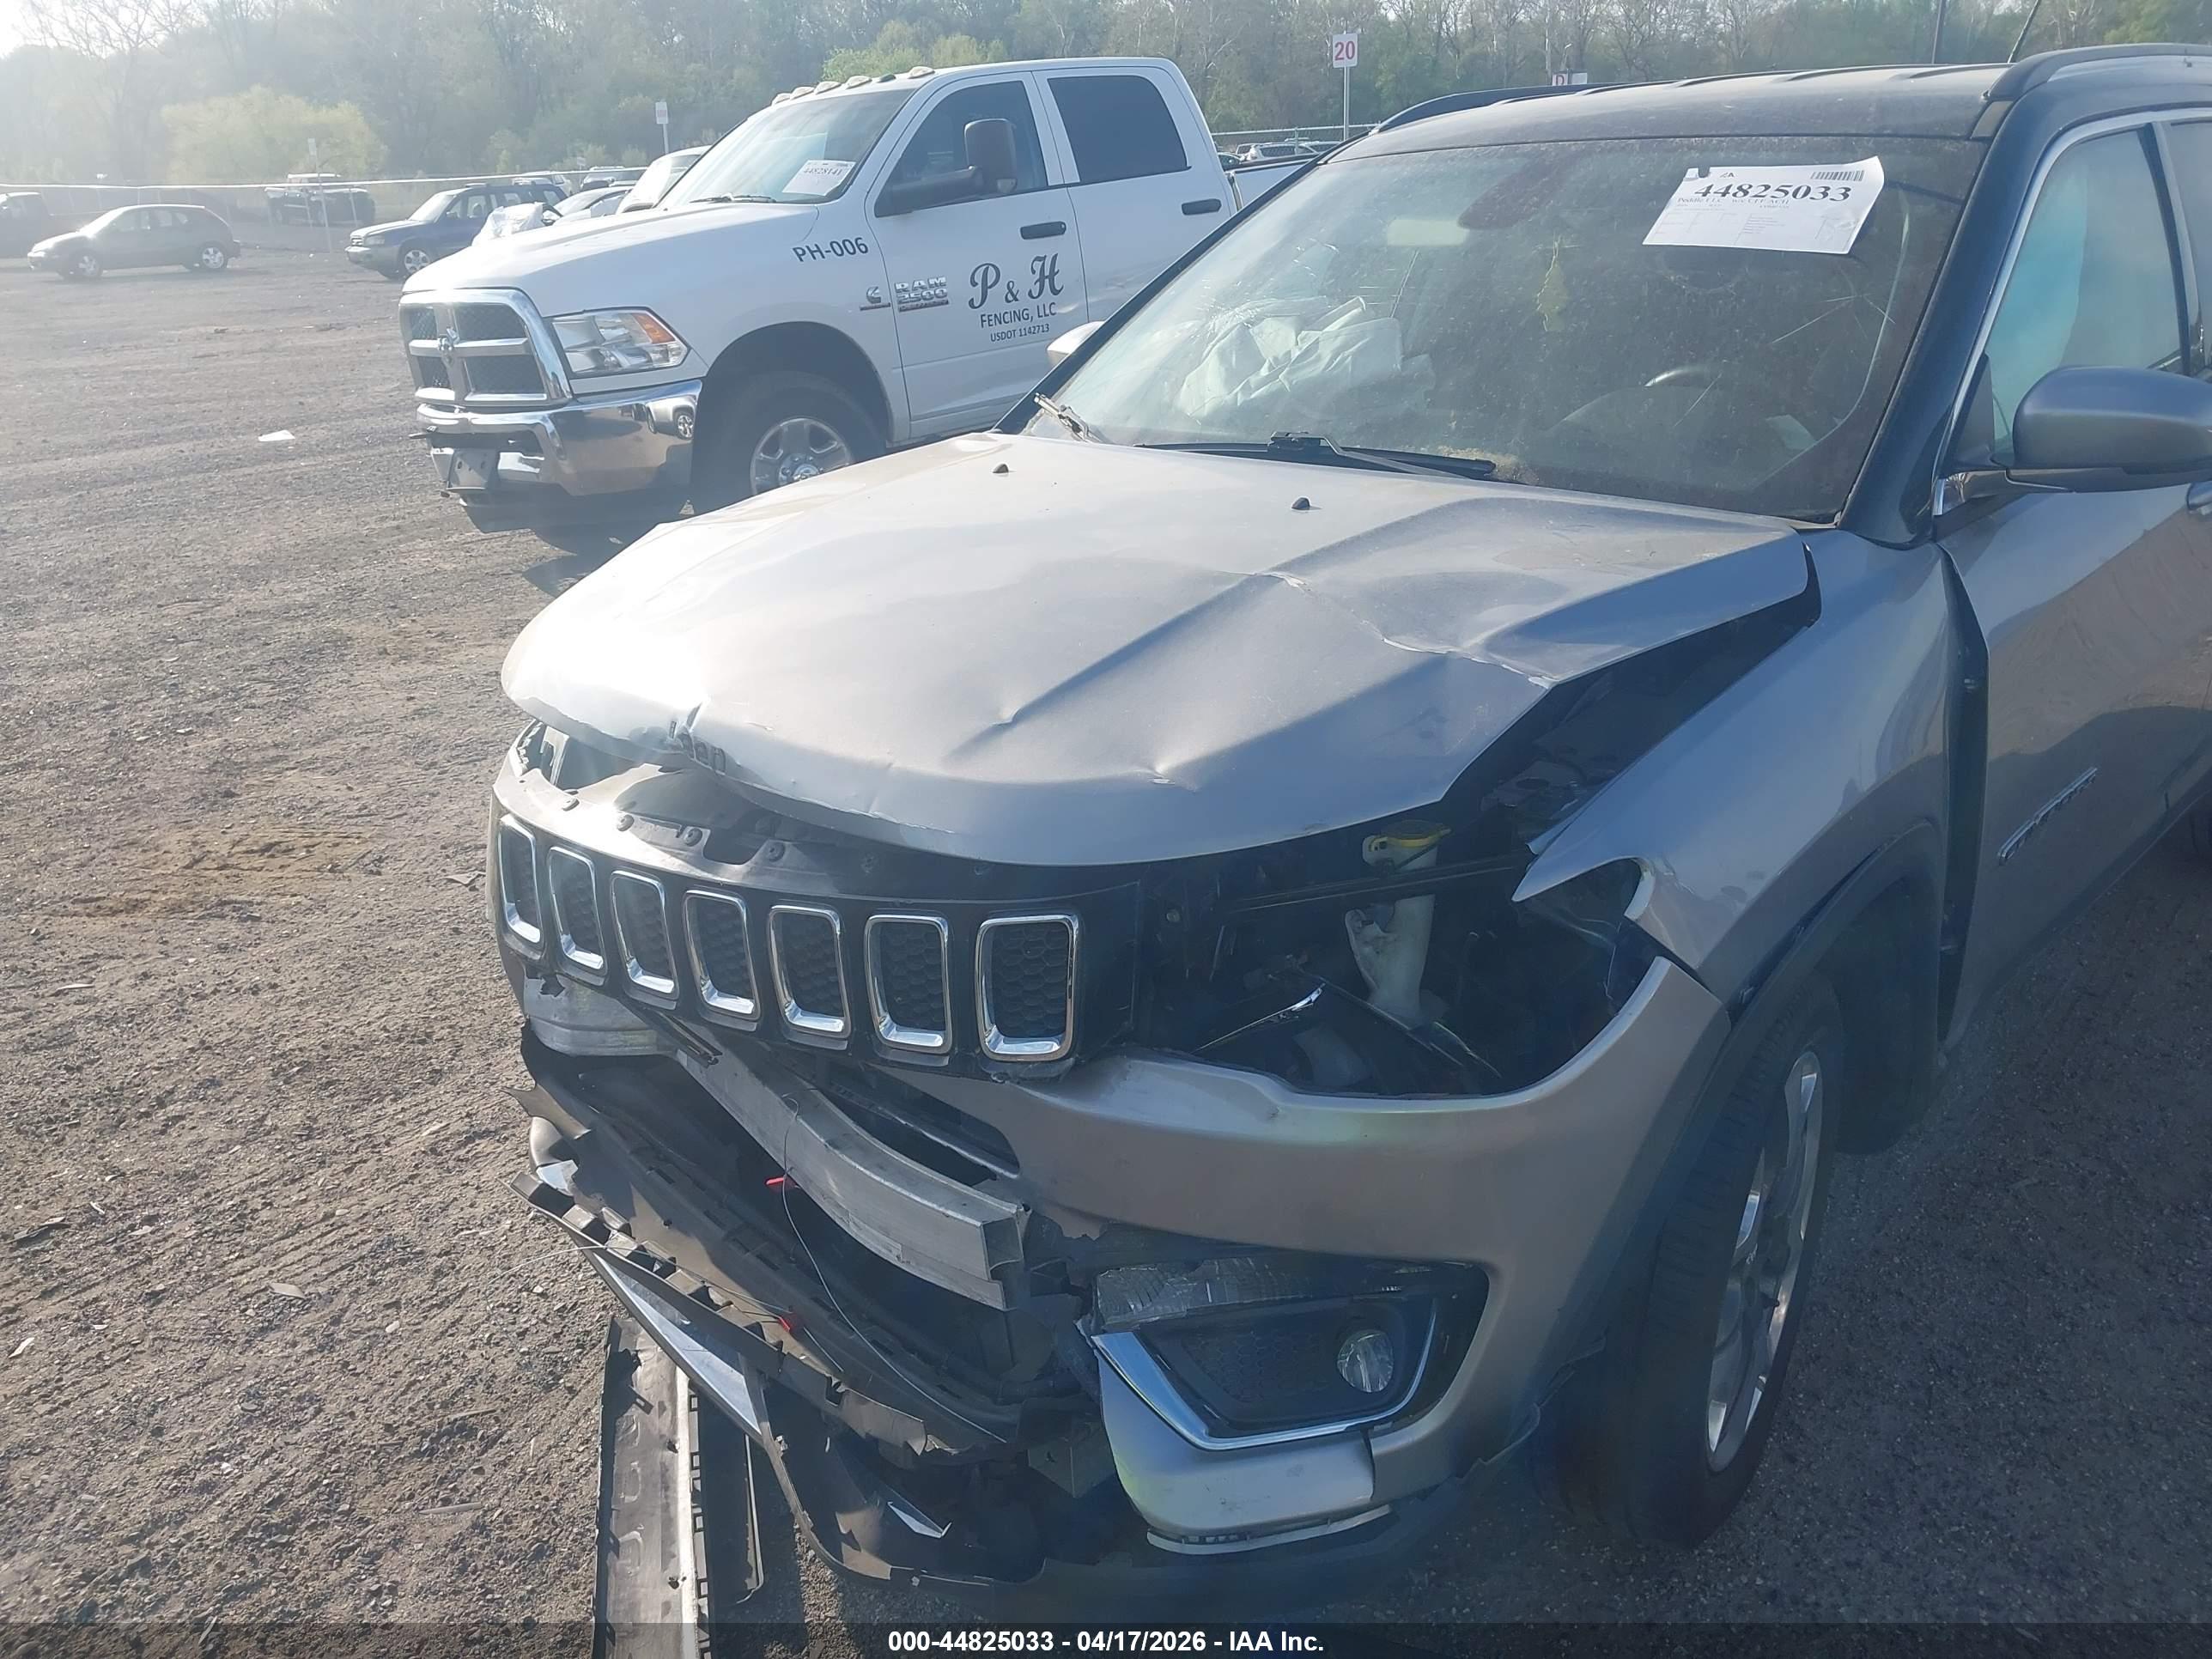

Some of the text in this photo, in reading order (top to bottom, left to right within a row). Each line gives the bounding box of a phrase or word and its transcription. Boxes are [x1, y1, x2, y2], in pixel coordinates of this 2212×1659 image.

[1334, 40, 1356, 60] 20
[1694, 183, 1852, 202] 44825033
[793, 237, 869, 262] PH-006
[894, 276, 946, 293] RAM
[969, 252, 1064, 309] P & H
[980, 302, 1057, 328] FENCING, LLC
[990, 324, 1050, 342] USDOT 1142713
